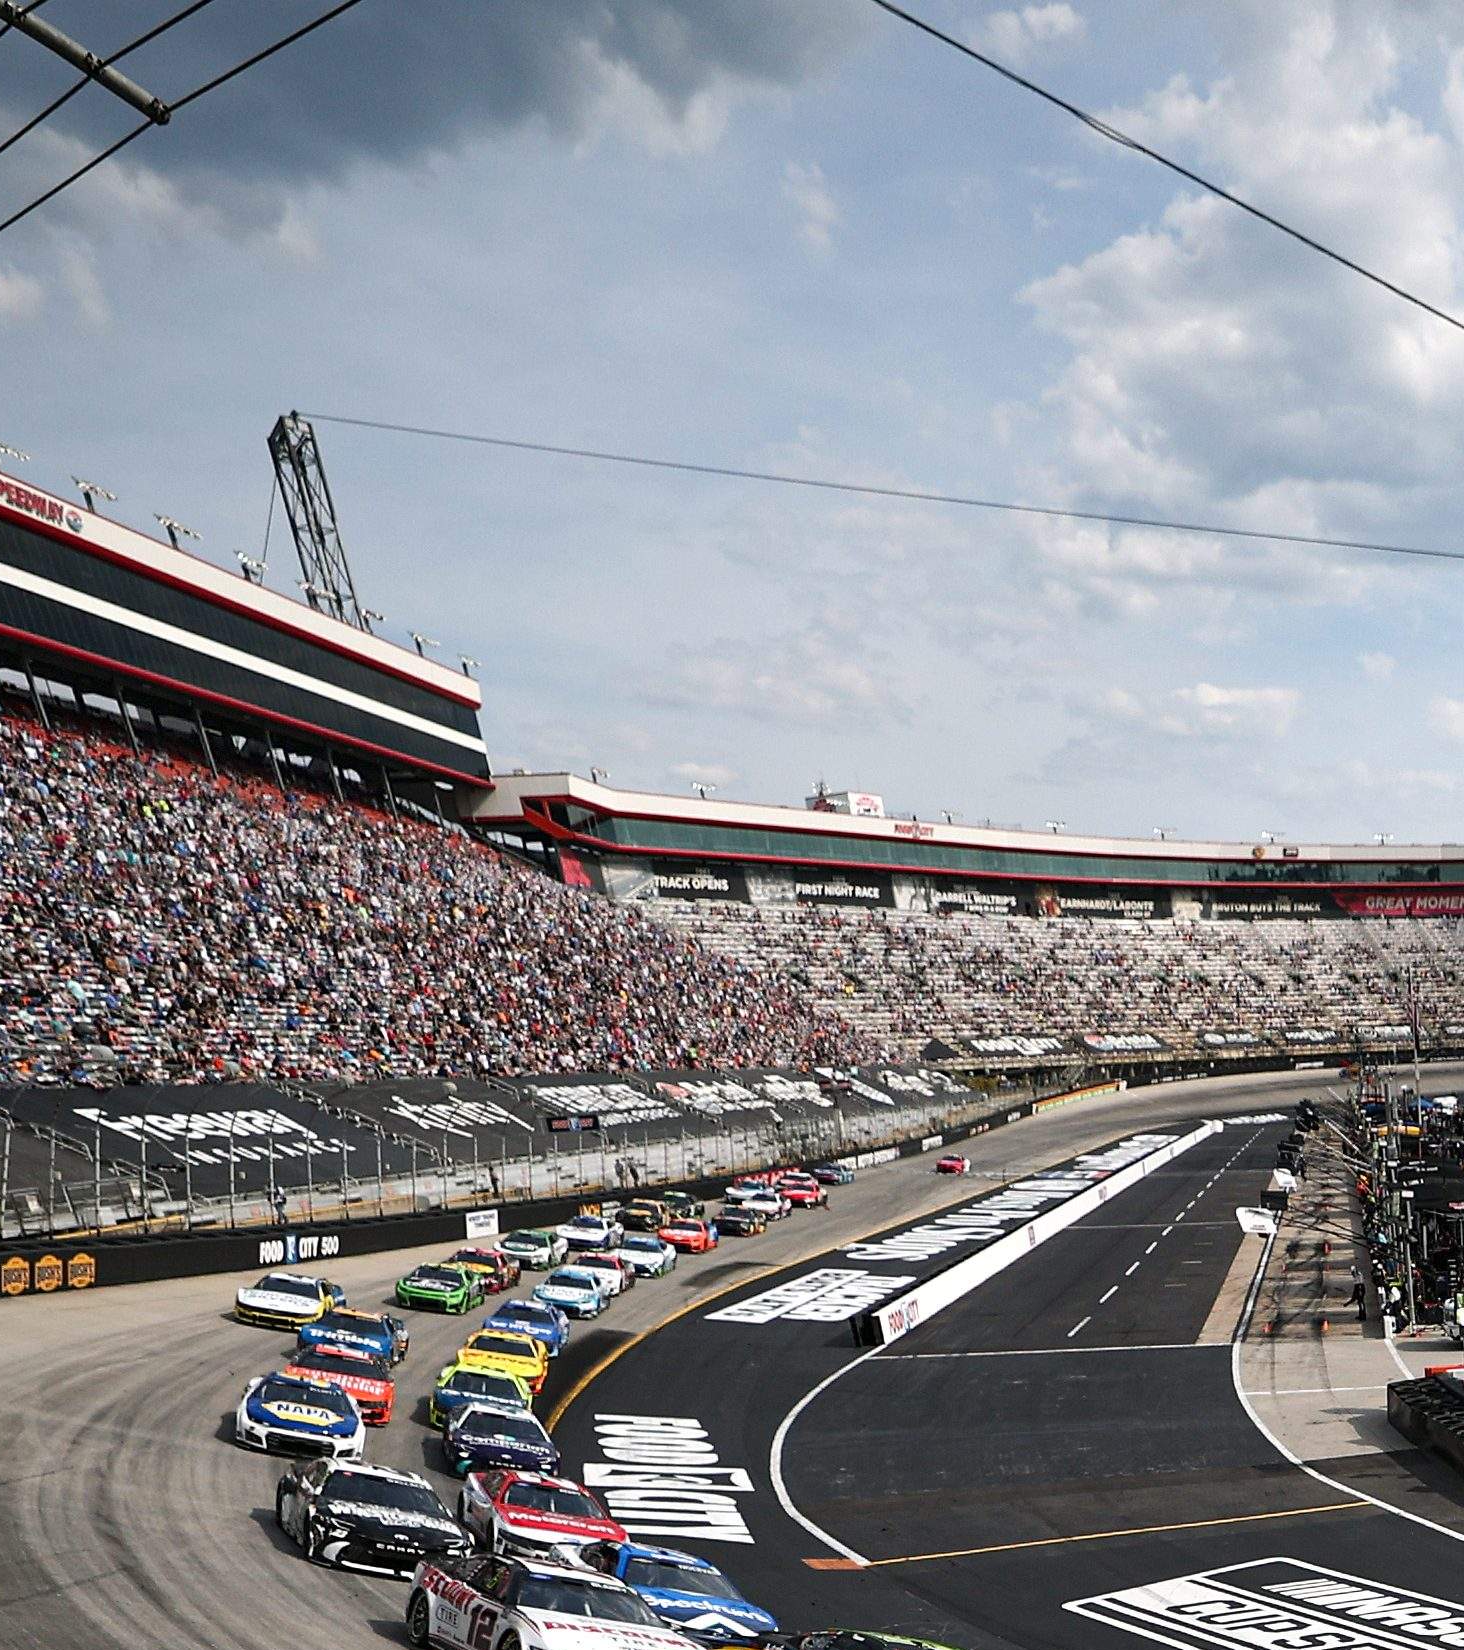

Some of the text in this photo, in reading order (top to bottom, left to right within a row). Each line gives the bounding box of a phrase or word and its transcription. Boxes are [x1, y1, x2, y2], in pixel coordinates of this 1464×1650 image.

[655, 875, 729, 892] TRACK OPENS
[795, 883, 880, 899] FIRST NIGHT RACE
[1293, 901, 1321, 913] TRACK
[1366, 895, 1413, 909] GREAT
[72, 1105, 319, 1140] Freeway
[384, 1096, 535, 1138] xfinity
[172, 1138, 358, 1166] INSURANCE
[259, 1235, 340, 1264] FOOD CITY 500
[888, 1304, 905, 1335] FOOD
[277, 1402, 331, 1420] NAPA
[593, 1413, 720, 1466] FOOD
[508, 1511, 616, 1536] Motorcraft
[375, 1542, 426, 1556] CAMRY
[643, 1594, 769, 1624] Spectrum
[542, 1620, 699, 1650] DISCOUNT
[1166, 1599, 1312, 1648] CUP
